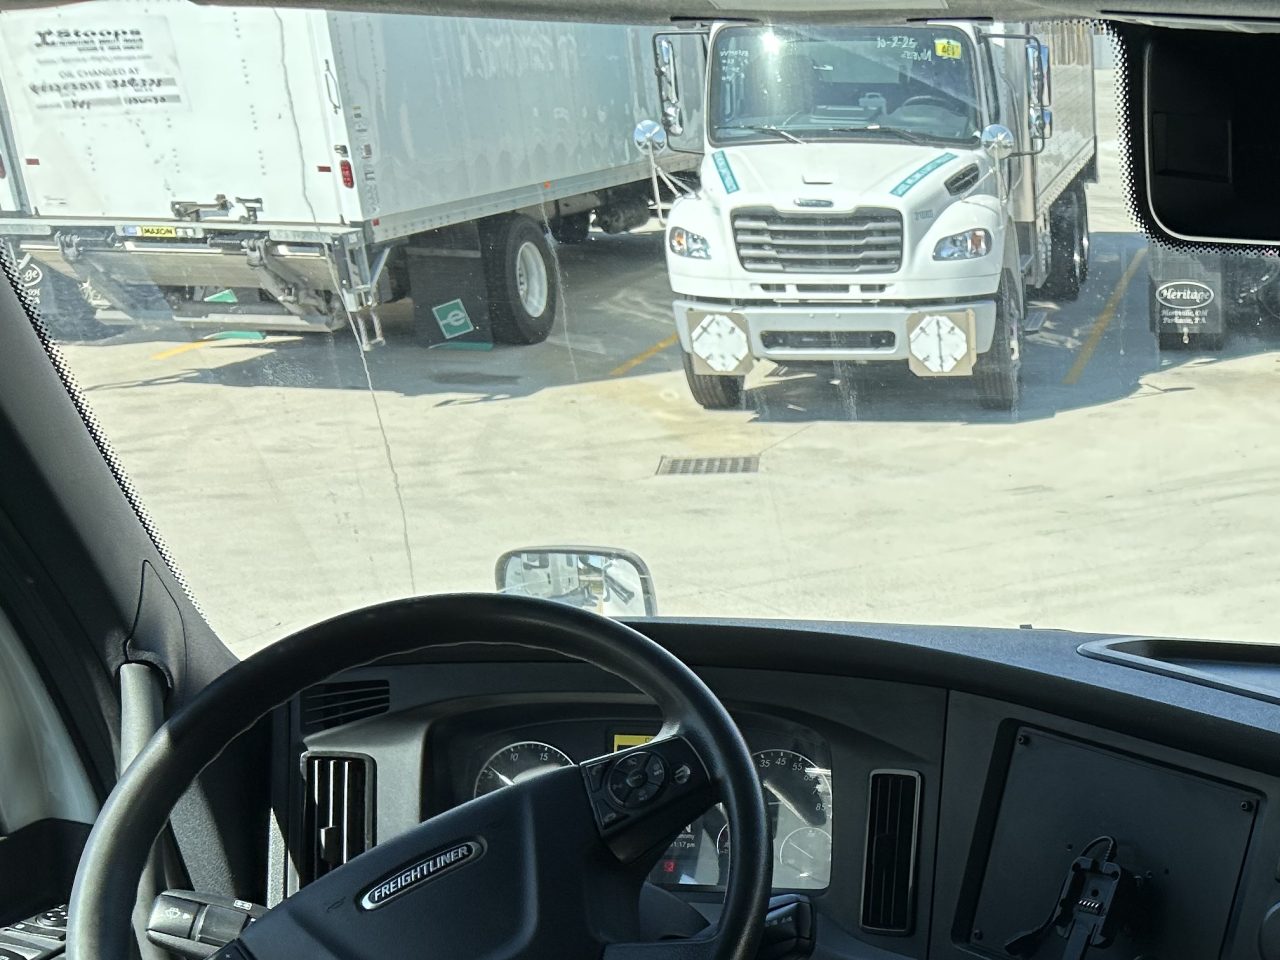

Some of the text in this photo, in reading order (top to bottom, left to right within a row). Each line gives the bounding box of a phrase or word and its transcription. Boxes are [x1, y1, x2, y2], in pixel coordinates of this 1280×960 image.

[77, 67, 128, 78] CHANGED
[128, 66, 140, 76] AT
[143, 226, 173, 236] MAXON
[1159, 287, 1210, 303] Heritage
[510, 753, 519, 761] 10
[540, 752, 549, 761] 15
[760, 759, 771, 768] 35
[775, 757, 787, 766] 45
[792, 762, 803, 771] 55
[487, 770, 494, 779] 5
[815, 802, 826, 811] 85
[374, 845, 469, 901] FREIGHTLINER
